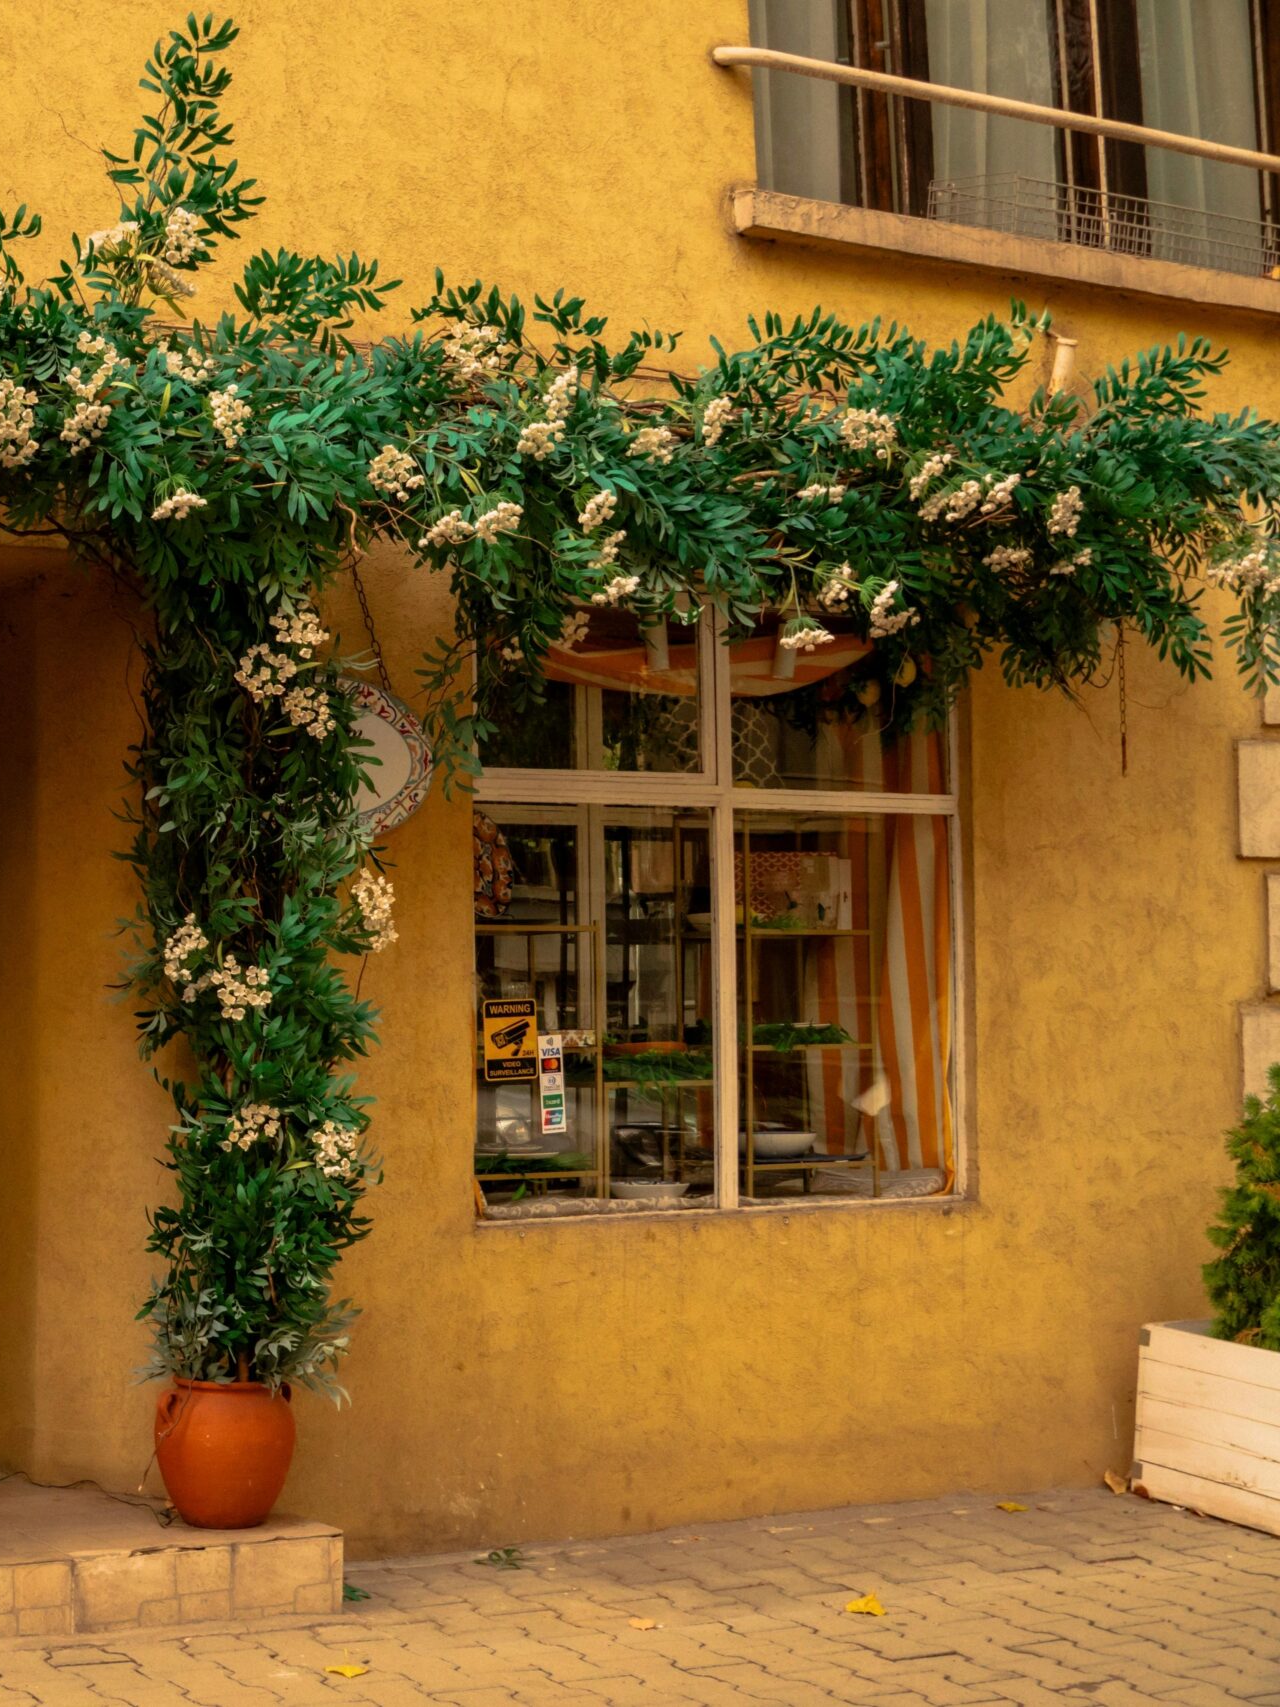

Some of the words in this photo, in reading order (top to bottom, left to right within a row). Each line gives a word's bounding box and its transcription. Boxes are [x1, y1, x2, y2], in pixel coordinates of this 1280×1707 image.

[490, 1004, 530, 1014] WARNING
[541, 1048, 560, 1056] VISA
[490, 1068, 534, 1076] SURVEILLANCE
